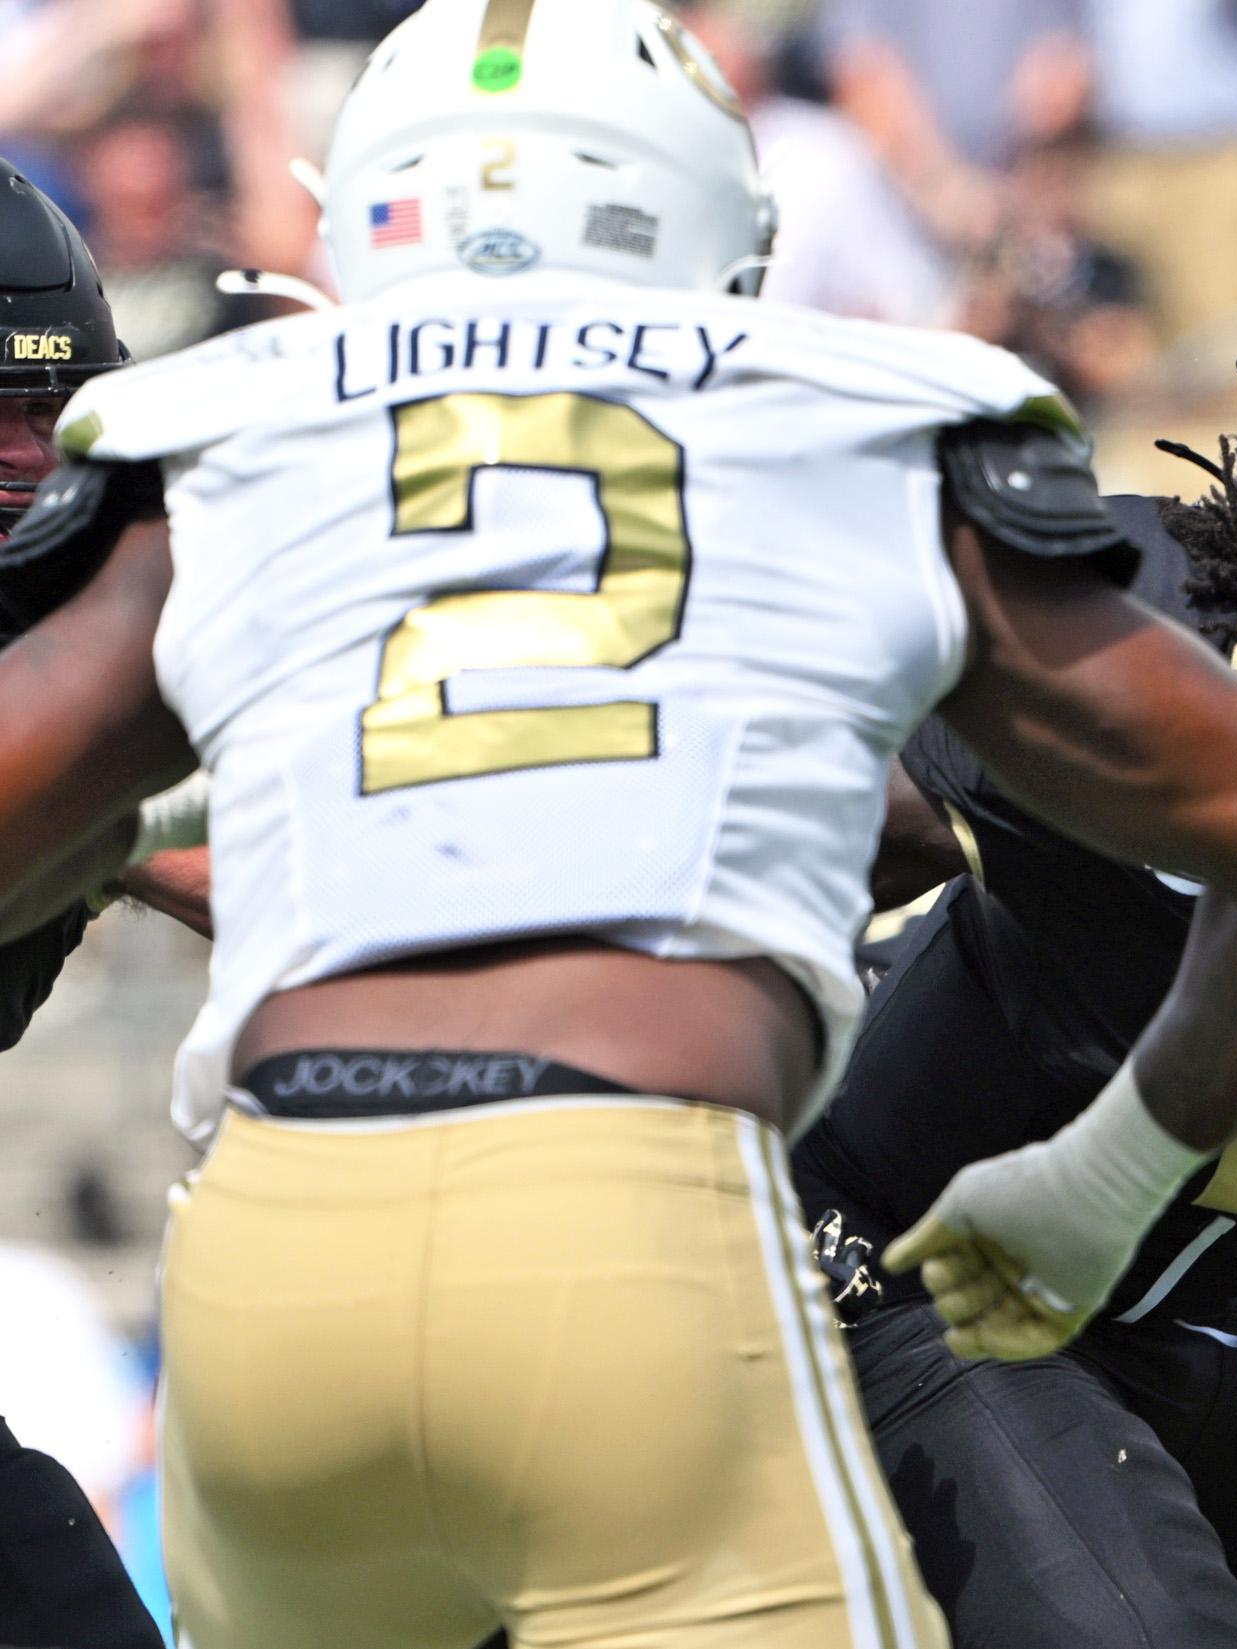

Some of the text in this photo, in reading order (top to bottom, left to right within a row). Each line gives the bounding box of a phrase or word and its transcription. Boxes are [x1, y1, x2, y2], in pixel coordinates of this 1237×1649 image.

[481, 138, 517, 191] 2
[14, 334, 72, 360] DEACS
[336, 319, 748, 403] LIGHTSEY
[357, 391, 693, 797] 2
